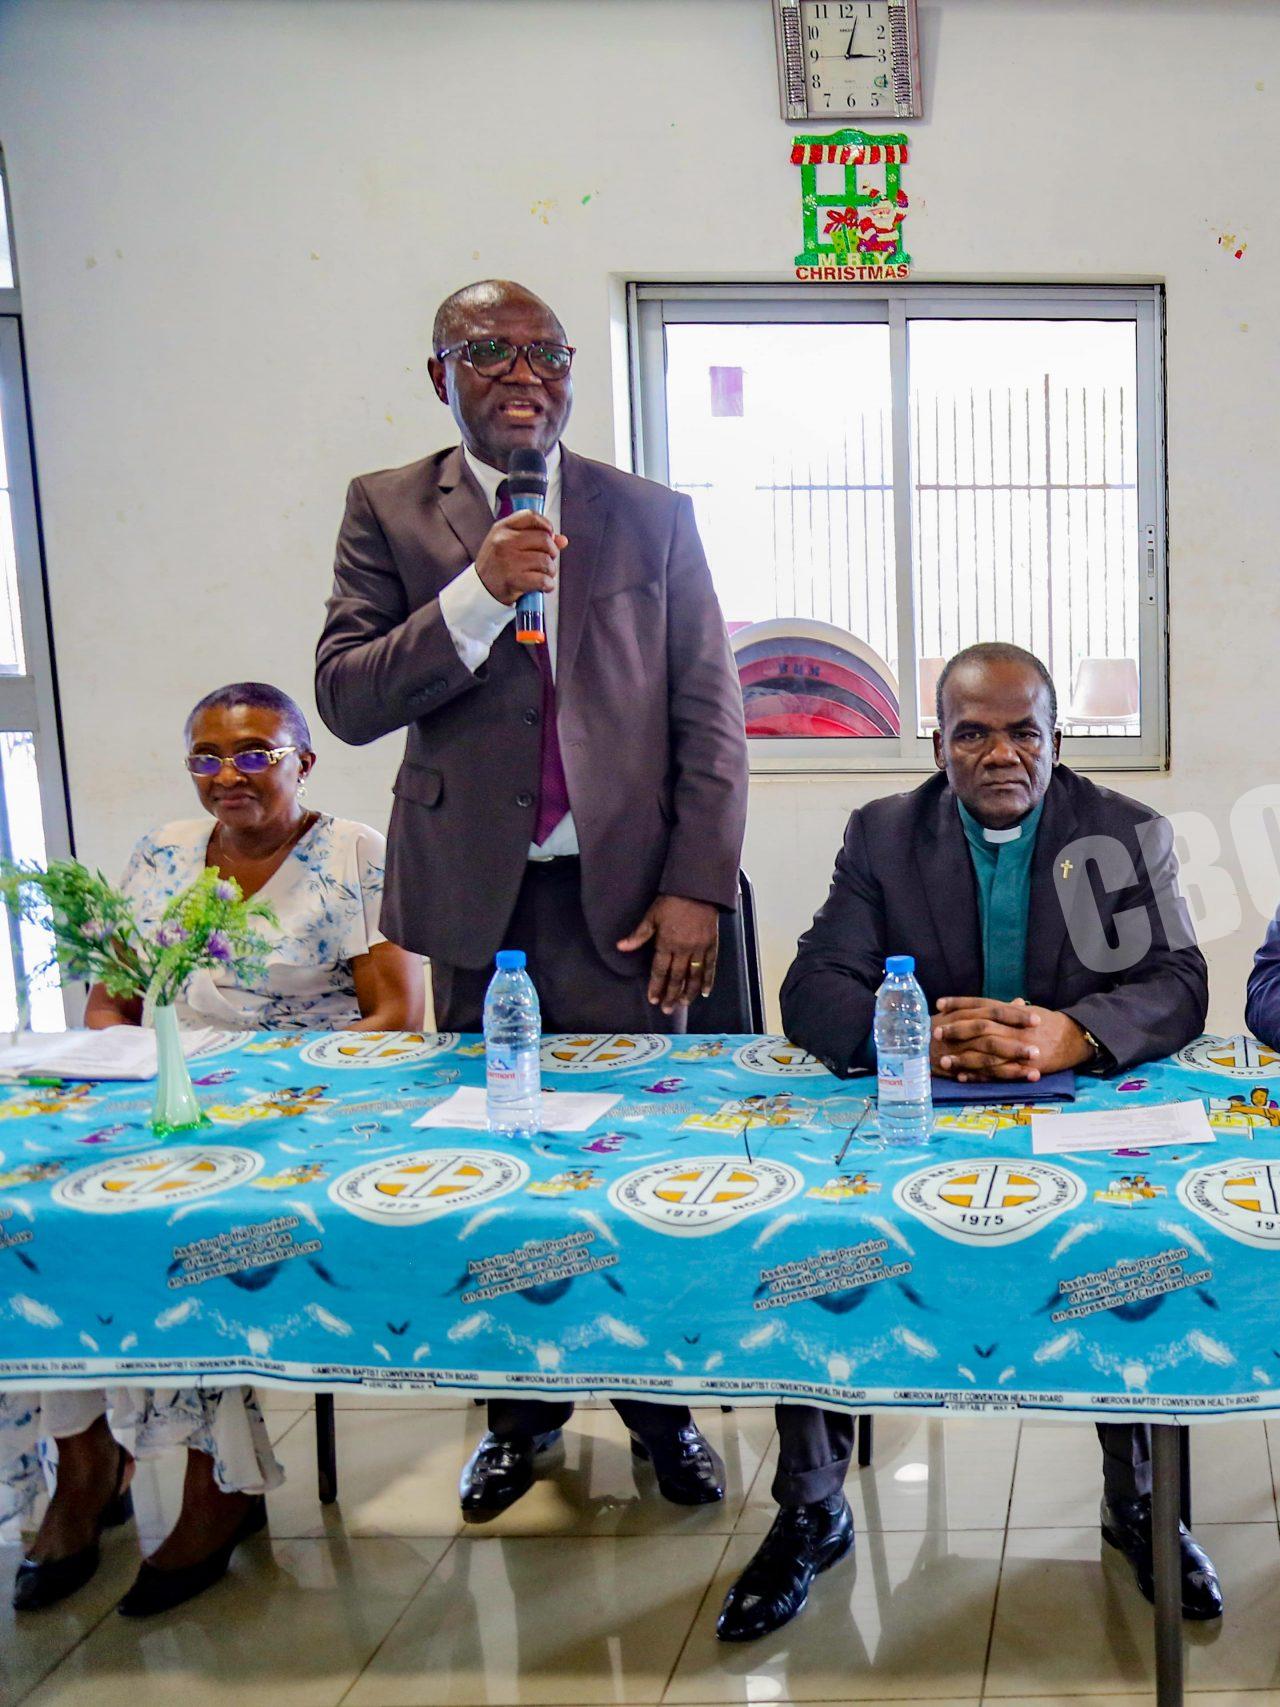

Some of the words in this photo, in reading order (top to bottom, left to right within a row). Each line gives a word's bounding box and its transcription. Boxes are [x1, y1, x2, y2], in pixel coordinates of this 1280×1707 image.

[815, 4, 828, 19] 11
[839, 4, 853, 18] 12
[807, 25, 819, 40] 10
[876, 25, 885, 40] 2
[810, 49, 819, 63] 9
[878, 48, 887, 63] 3
[812, 74, 821, 89] 8
[823, 93, 831, 108] 7
[847, 93, 856, 108] 6
[871, 93, 879, 107] 5
[818, 252, 888, 266] MERRY
[795, 263, 909, 281] CHRISTMAS
[959, 1213, 1004, 1226] 1975
[760, 1261, 809, 1281] Assisting
[838, 1239, 887, 1259] Provision
[782, 1273, 816, 1288] Health
[816, 1267, 841, 1280] Care
[1060, 1272, 1107, 1292] Assisting
[1139, 1249, 1187, 1269] Provision
[769, 1286, 825, 1306] expression
[839, 1270, 884, 1289] Christian
[886, 1262, 911, 1276] Love
[1081, 1283, 1115, 1299] Health
[1115, 1278, 1141, 1290] Care
[1067, 1296, 1124, 1317] expression
[1137, 1279, 1184, 1298] Christian
[1185, 1271, 1211, 1284] Love
